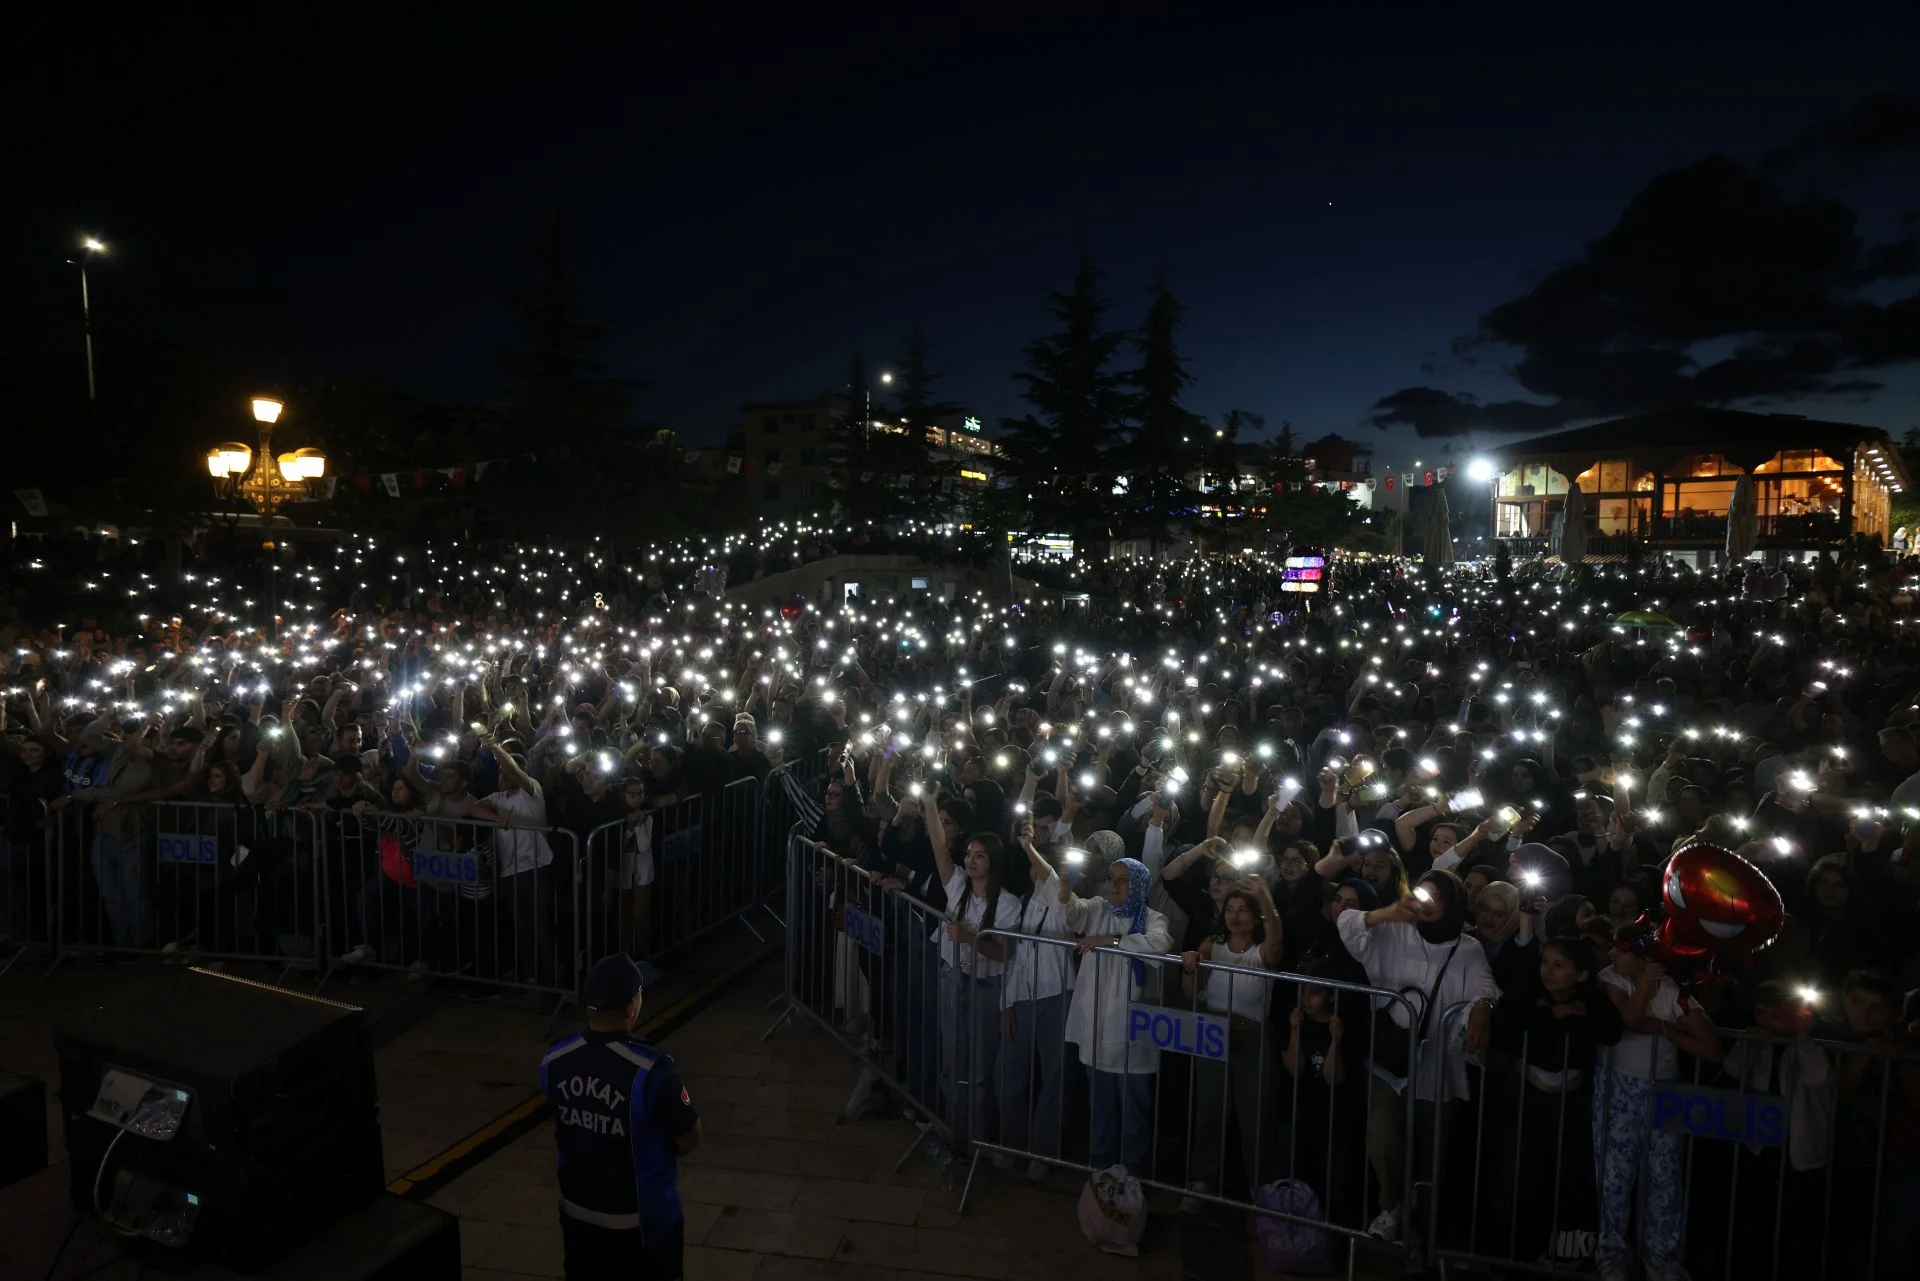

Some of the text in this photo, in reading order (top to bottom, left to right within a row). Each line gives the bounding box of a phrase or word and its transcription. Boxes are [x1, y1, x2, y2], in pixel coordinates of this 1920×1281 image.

[1130, 1010, 1224, 1058] POLİS
[557, 1076, 626, 1110] TOKAT
[557, 1104, 626, 1137] ZABITA
[1654, 1091, 1784, 1144] POLİS
